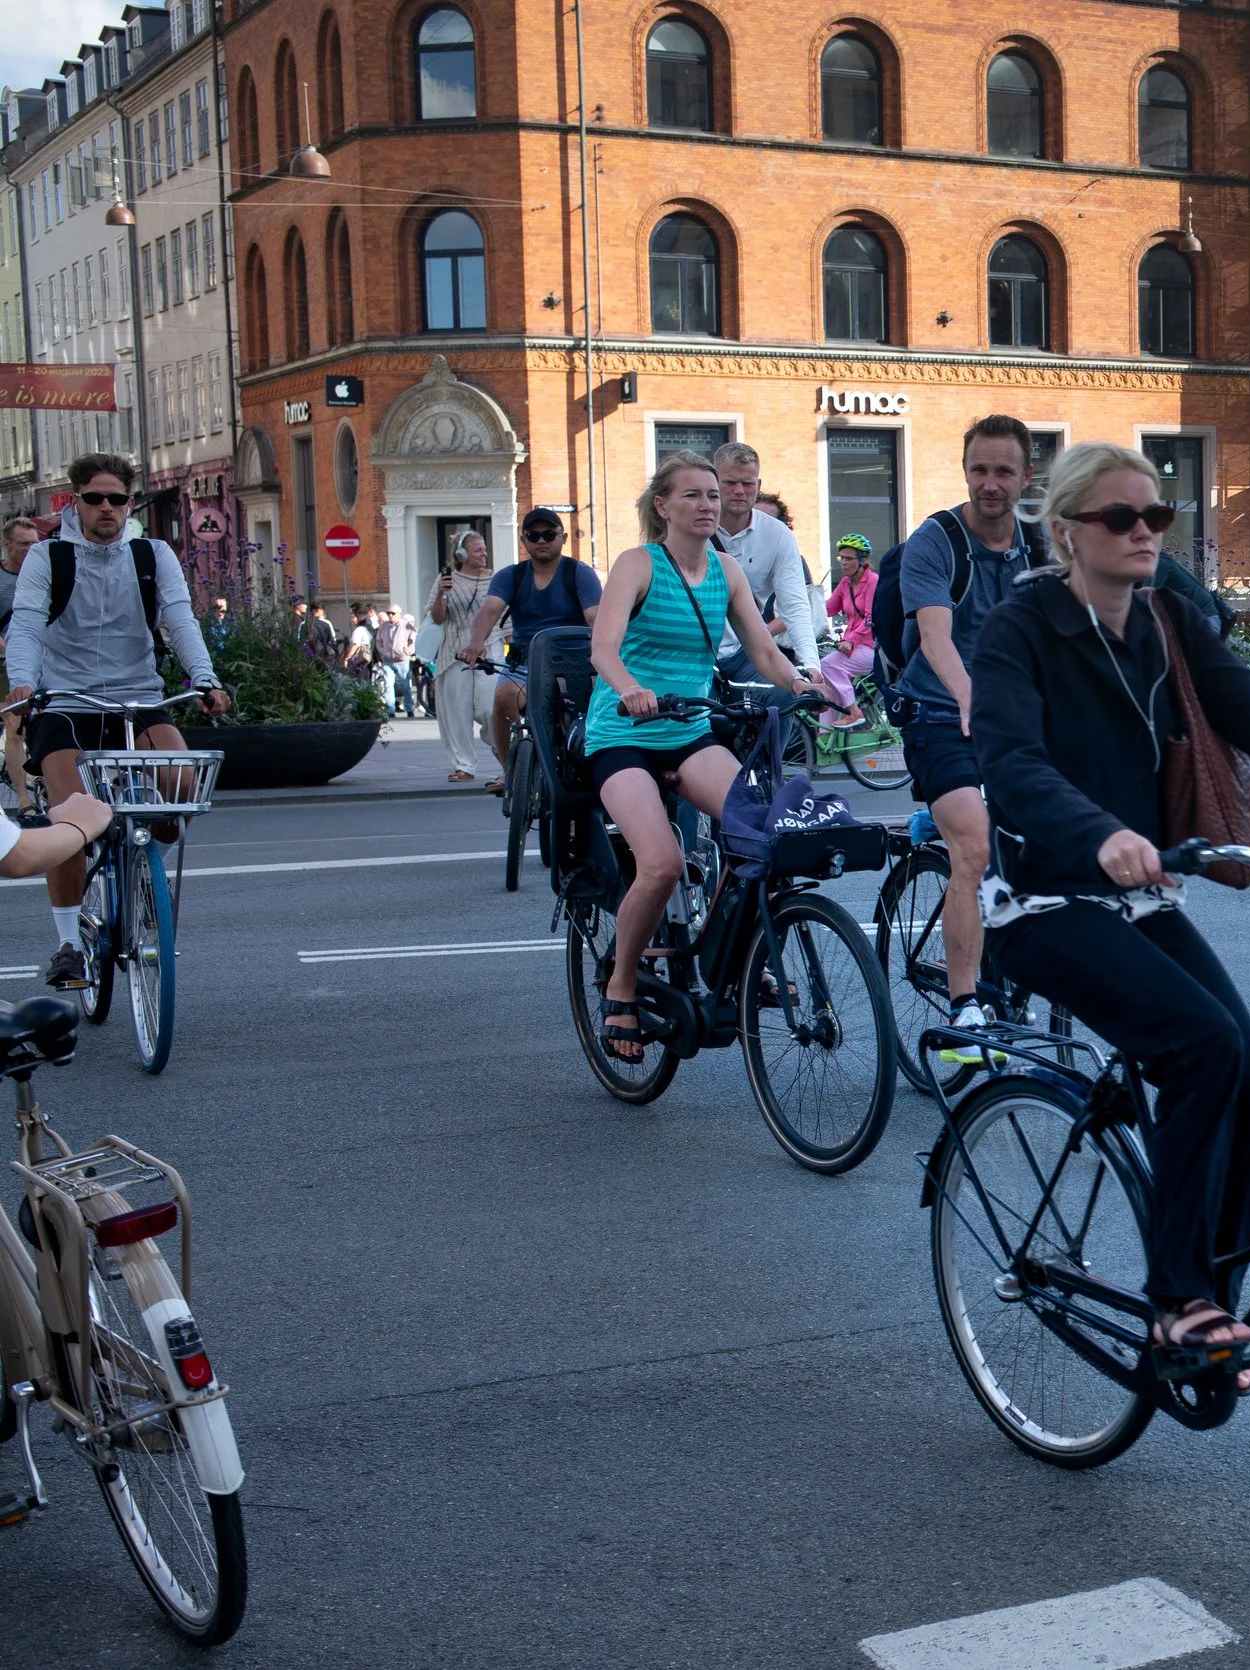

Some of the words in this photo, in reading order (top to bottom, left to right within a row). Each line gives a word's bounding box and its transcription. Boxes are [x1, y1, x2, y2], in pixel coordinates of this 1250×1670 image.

[85, 367, 111, 377] 2023
[15, 385, 35, 405] is
[42, 390, 110, 407] more
